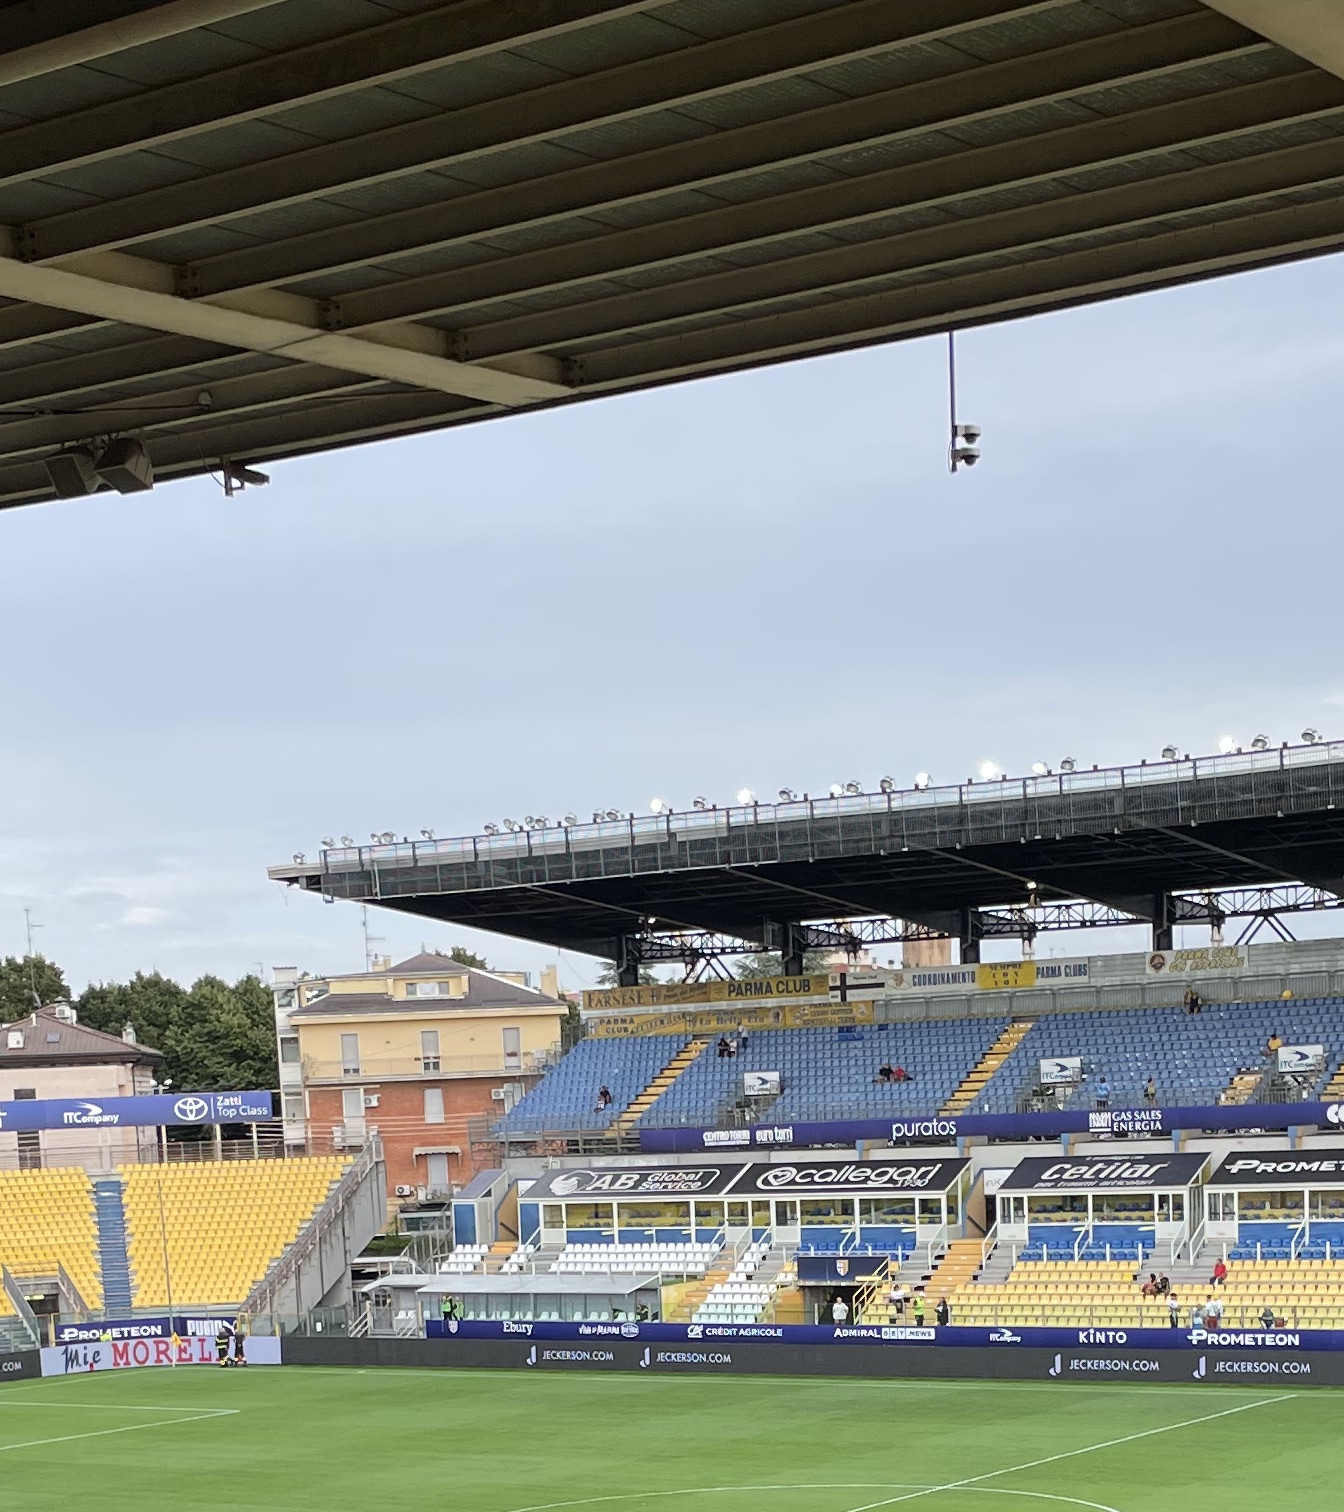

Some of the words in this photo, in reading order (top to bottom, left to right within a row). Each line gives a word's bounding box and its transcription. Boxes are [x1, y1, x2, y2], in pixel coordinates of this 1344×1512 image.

[912, 970, 976, 987] COORDINAMENTO
[1035, 966, 1062, 979] PARMA
[1064, 964, 1088, 978] CLUBS
[727, 983, 773, 997] PARMA
[775, 979, 811, 993] CLUB
[217, 1095, 241, 1106] Zatti
[63, 1110, 119, 1124] ITCompany
[217, 1106, 237, 1118] Top
[239, 1104, 268, 1116] Class
[1112, 1111, 1132, 1121] GAS
[1134, 1110, 1162, 1120] SALES
[892, 1118, 956, 1139] puratos
[1113, 1120, 1162, 1131] ENERGIA
[755, 1131, 773, 1142] euro
[774, 1125, 793, 1142] torri
[647, 1170, 702, 1183] Global
[794, 1163, 943, 1188] callegari
[1040, 1161, 1172, 1181] Cetilar
[585, 1174, 640, 1191] AB
[638, 1180, 703, 1191] Service
[502, 1320, 533, 1336] Ebury
[706, 1327, 737, 1337] CRÉDIT
[739, 1328, 783, 1337] AGRICOLE
[833, 1327, 881, 1339] ADMIRAL
[1187, 1328, 1300, 1347] PROMETEON
[111, 1338, 221, 1366] MOREL
[542, 1349, 614, 1362] JECKERSON.COM
[656, 1351, 732, 1364] JECKERSON.COM
[1068, 1359, 1160, 1373] JECKERSON.COM
[1214, 1361, 1312, 1375] JECKERSON.COM
